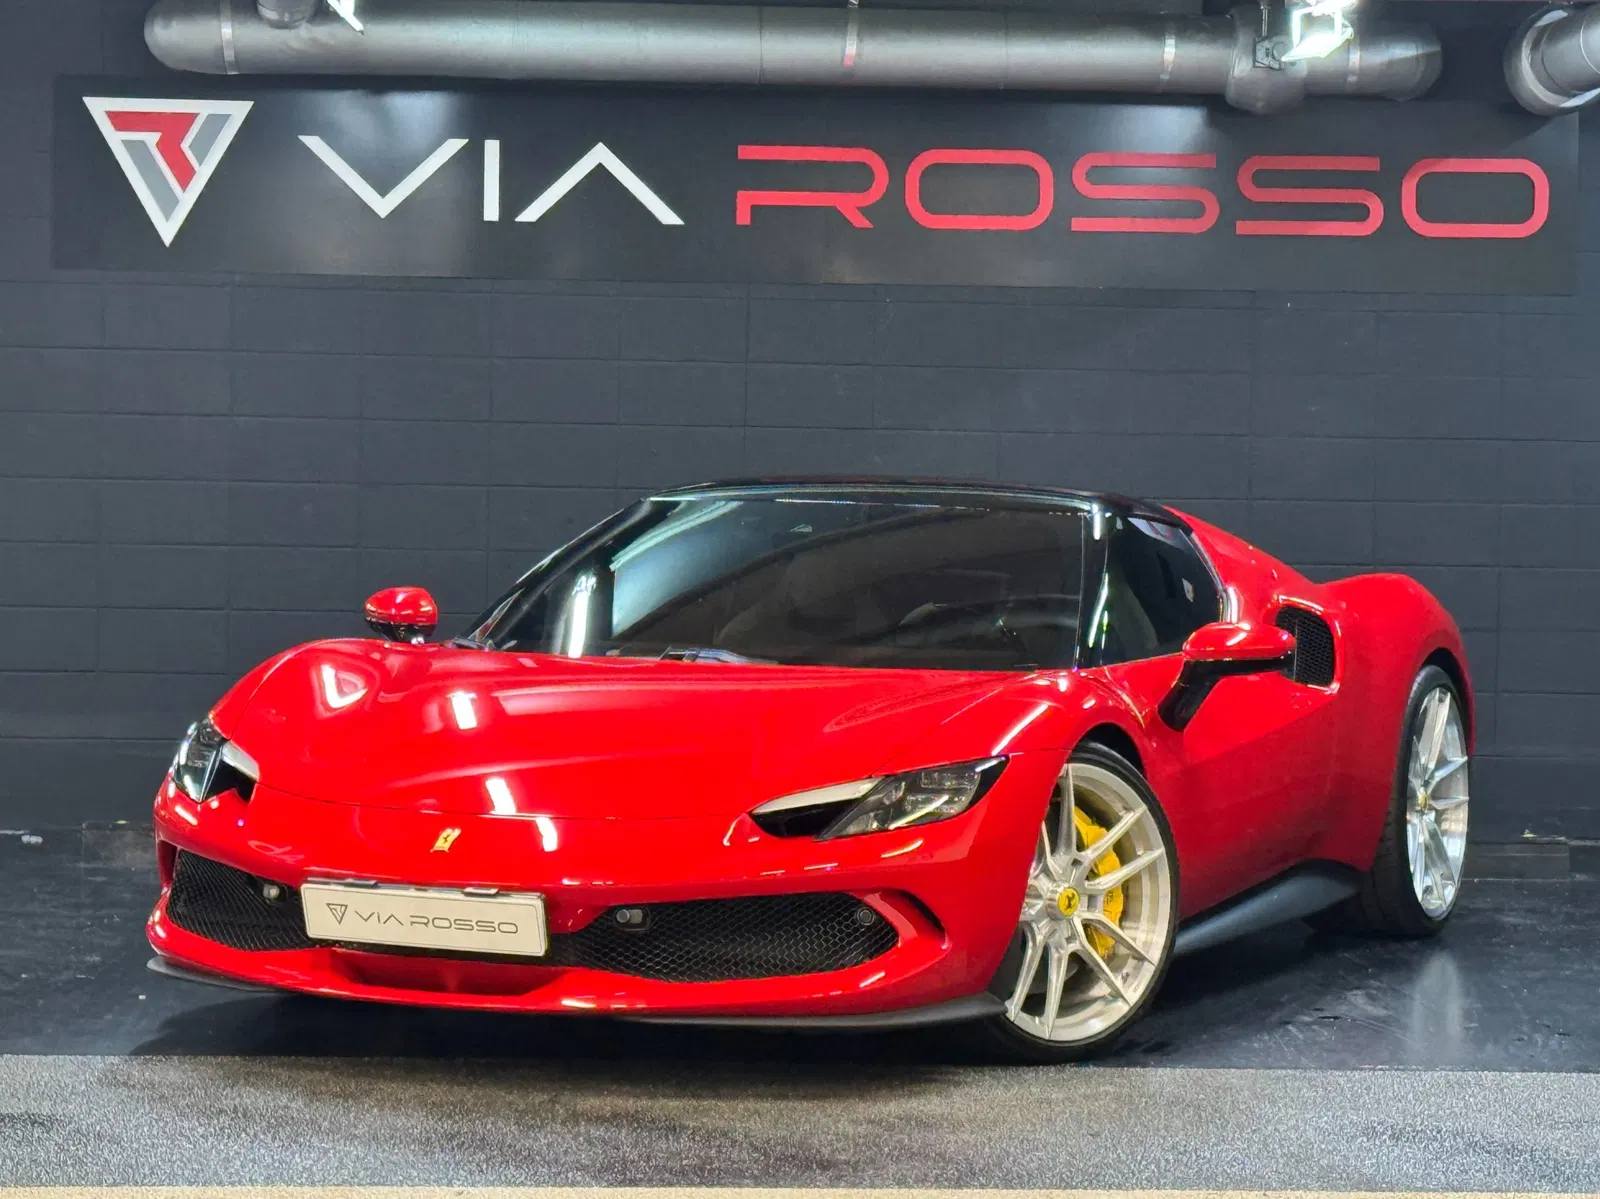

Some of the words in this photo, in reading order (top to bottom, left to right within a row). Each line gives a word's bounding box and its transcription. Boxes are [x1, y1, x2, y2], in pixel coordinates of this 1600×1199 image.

[298, 134, 685, 225] VIA
[736, 145, 1550, 239] ROSSO
[355, 911, 404, 927] VIA
[409, 915, 519, 934] ROSSO
